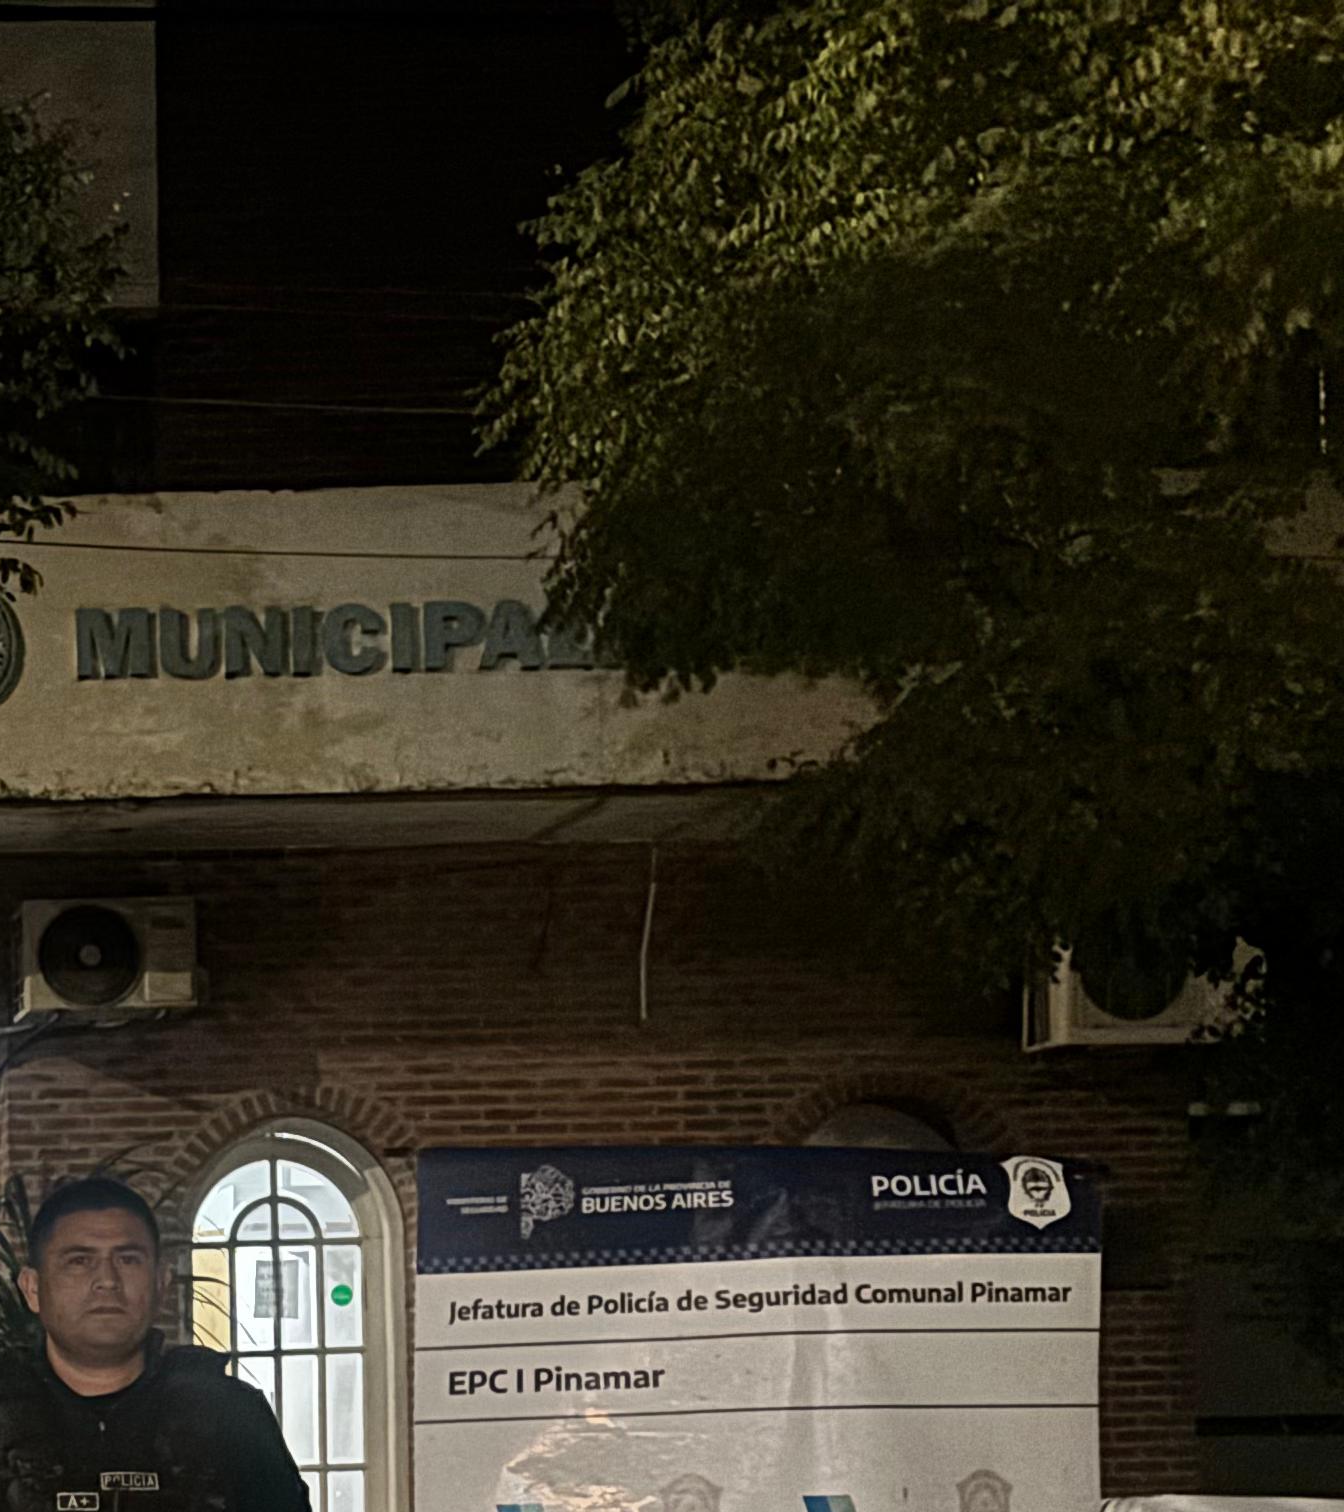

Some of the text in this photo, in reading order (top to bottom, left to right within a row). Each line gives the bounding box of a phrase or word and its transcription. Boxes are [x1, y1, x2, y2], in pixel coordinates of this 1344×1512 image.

[871, 1169, 987, 1197] POLICÍA
[581, 1190, 734, 1214] BUENOS AIRES
[448, 1279, 1072, 1325] Jefatura de Policía de Seguridad Comunal Pinamar
[448, 1368, 509, 1395] EPC
[533, 1363, 665, 1392] Pinamar
[67, 1495, 89, 1508] A+
